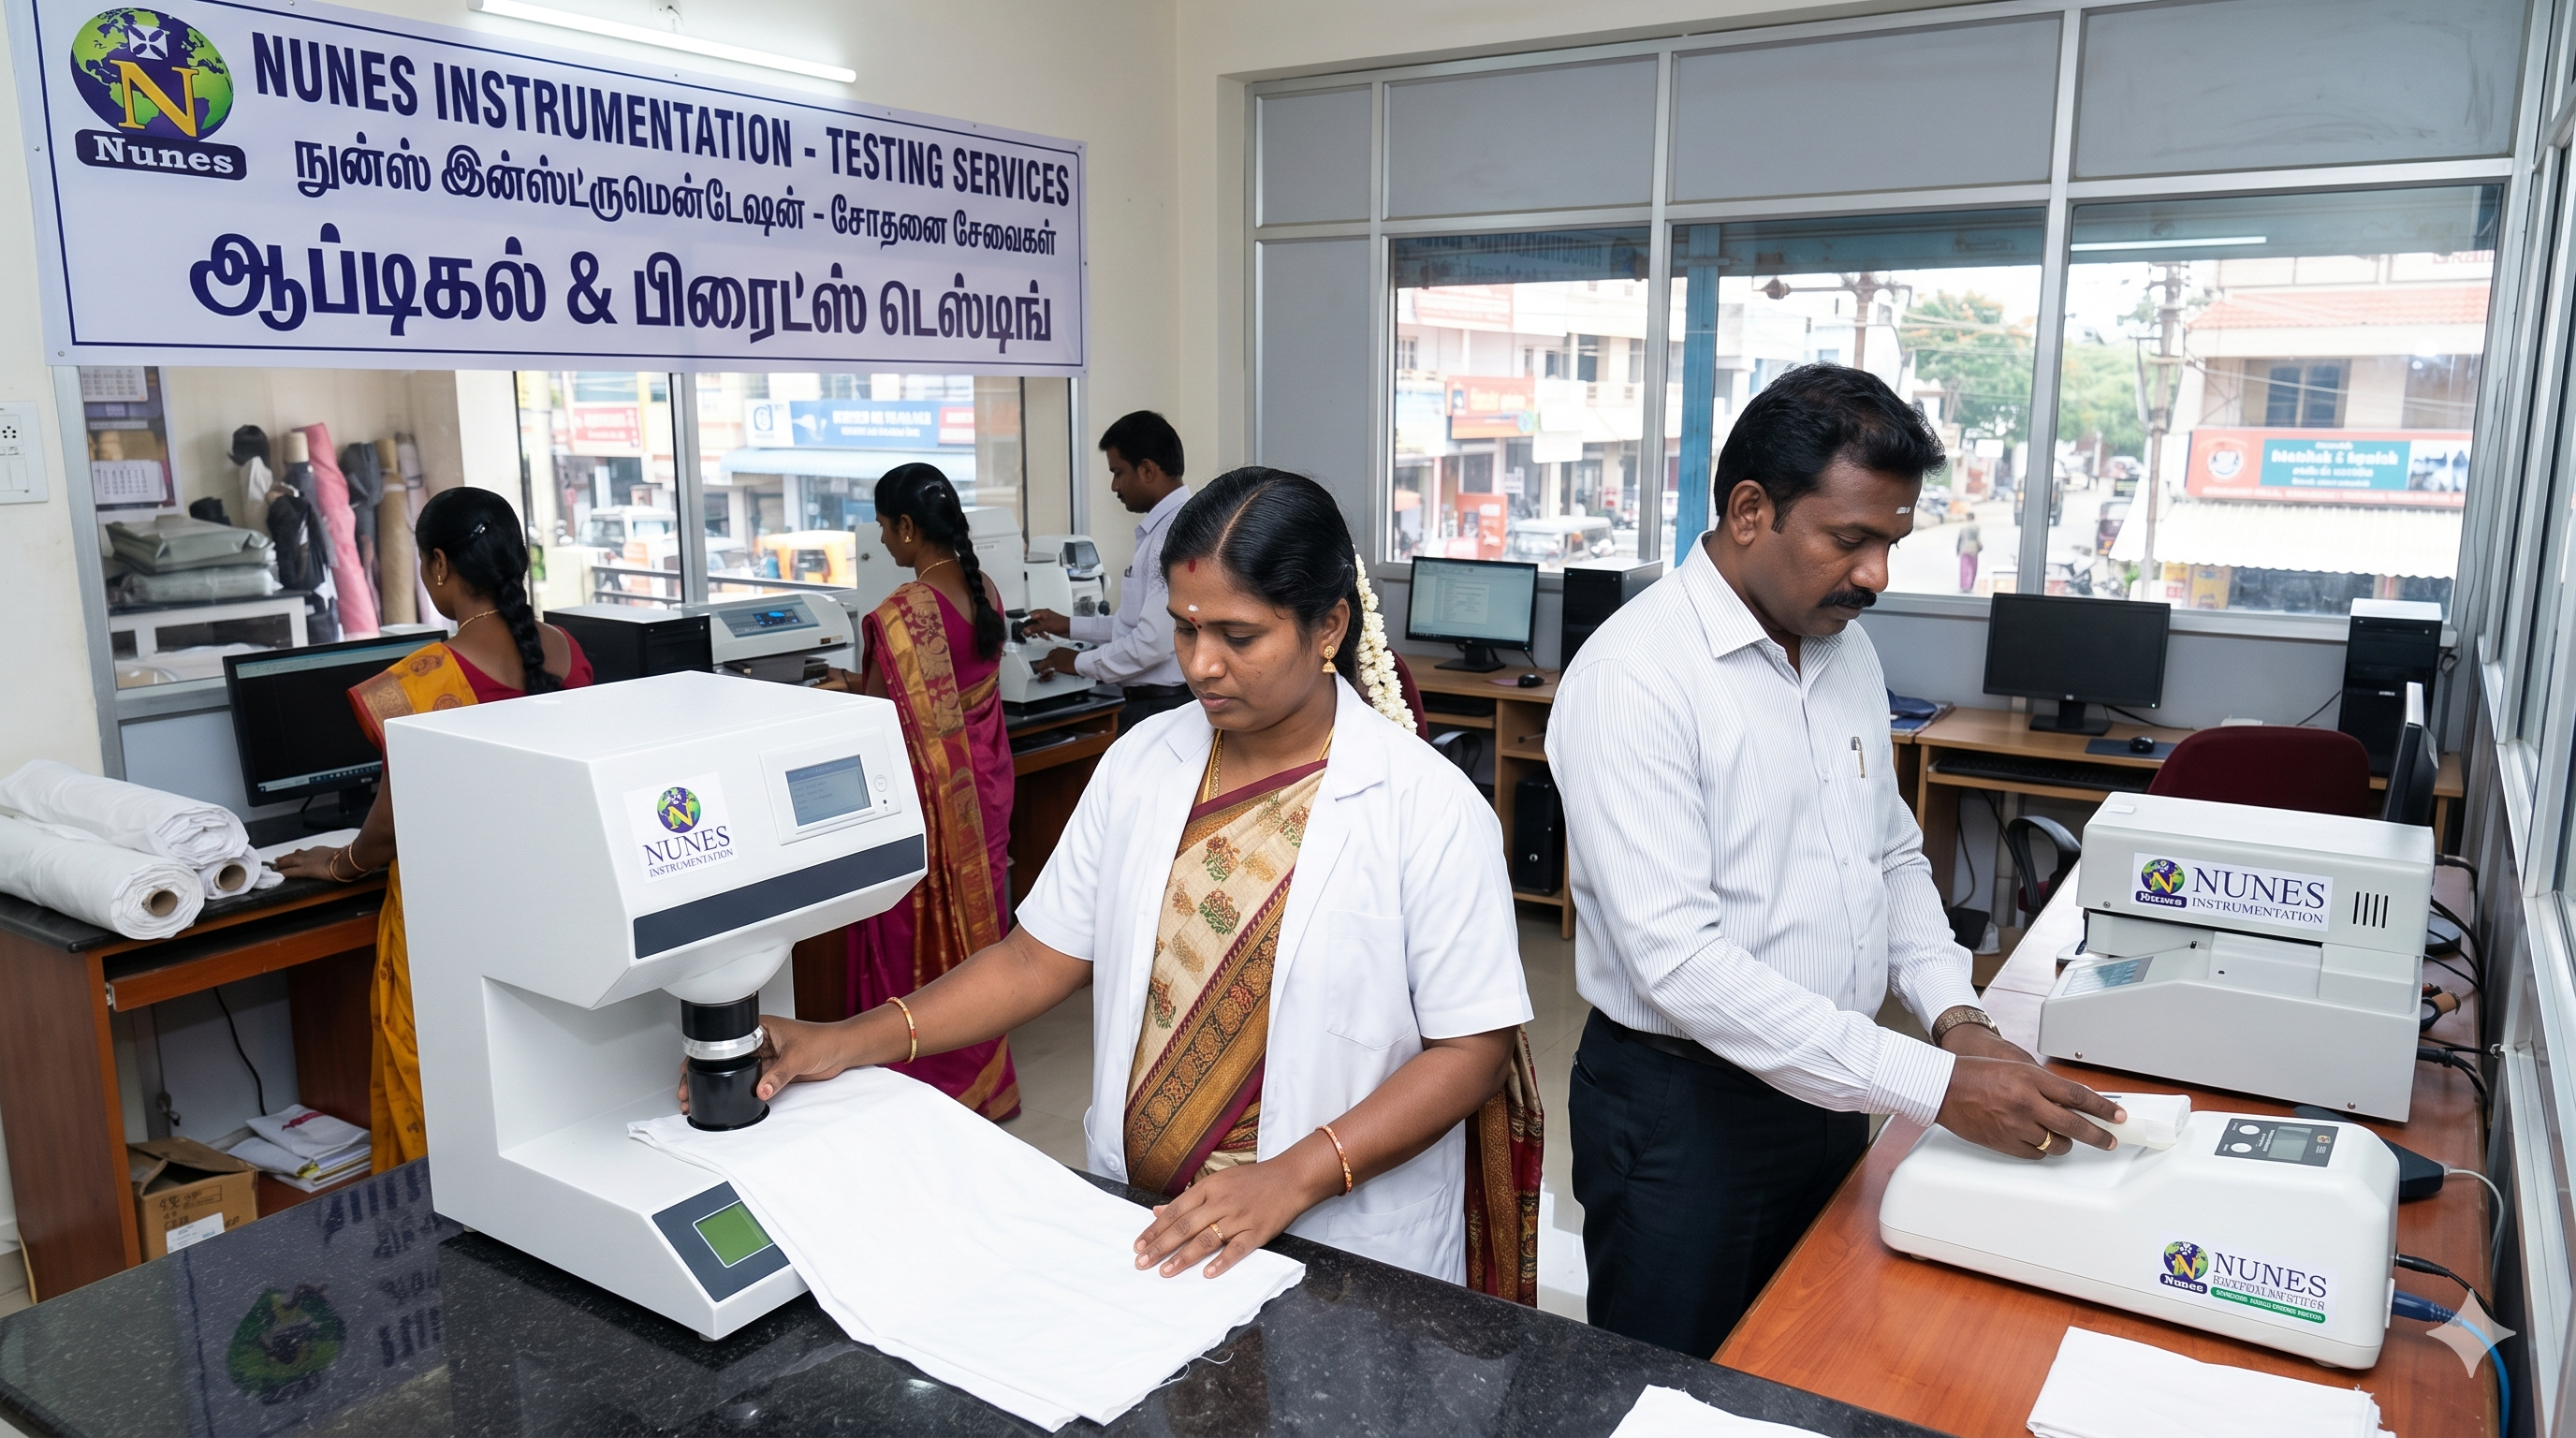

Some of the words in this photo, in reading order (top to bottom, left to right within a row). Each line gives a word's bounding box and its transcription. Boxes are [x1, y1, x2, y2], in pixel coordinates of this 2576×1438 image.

[110, 60, 199, 138] N
[251, 31, 418, 117] NUNES
[433, 63, 792, 169] INSTRUMENTATION
[804, 147, 815, 157] -
[826, 126, 944, 189] TESTING
[952, 147, 1070, 208] SERVICES
[93, 135, 234, 174] Nunes
[295, 131, 432, 198] நுன்ஸ்
[441, 144, 805, 237] இன்ஸ்ட்ருமென்டேஷன்
[830, 194, 947, 250] சோதனை
[953, 210, 1057, 256] சேவைகள்
[189, 222, 547, 337] ஆப்டிகல்
[566, 250, 619, 325] &
[633, 251, 868, 345] பிரைட்ஸ்
[880, 272, 1052, 354] டெஸ்டிங்
[643, 826, 730, 866] NUNES
[2192, 867, 2325, 909] NUNES
[2192, 897, 2323, 924] INSTRUMENTATION
[2213, 1252, 2327, 1299] NUNES
